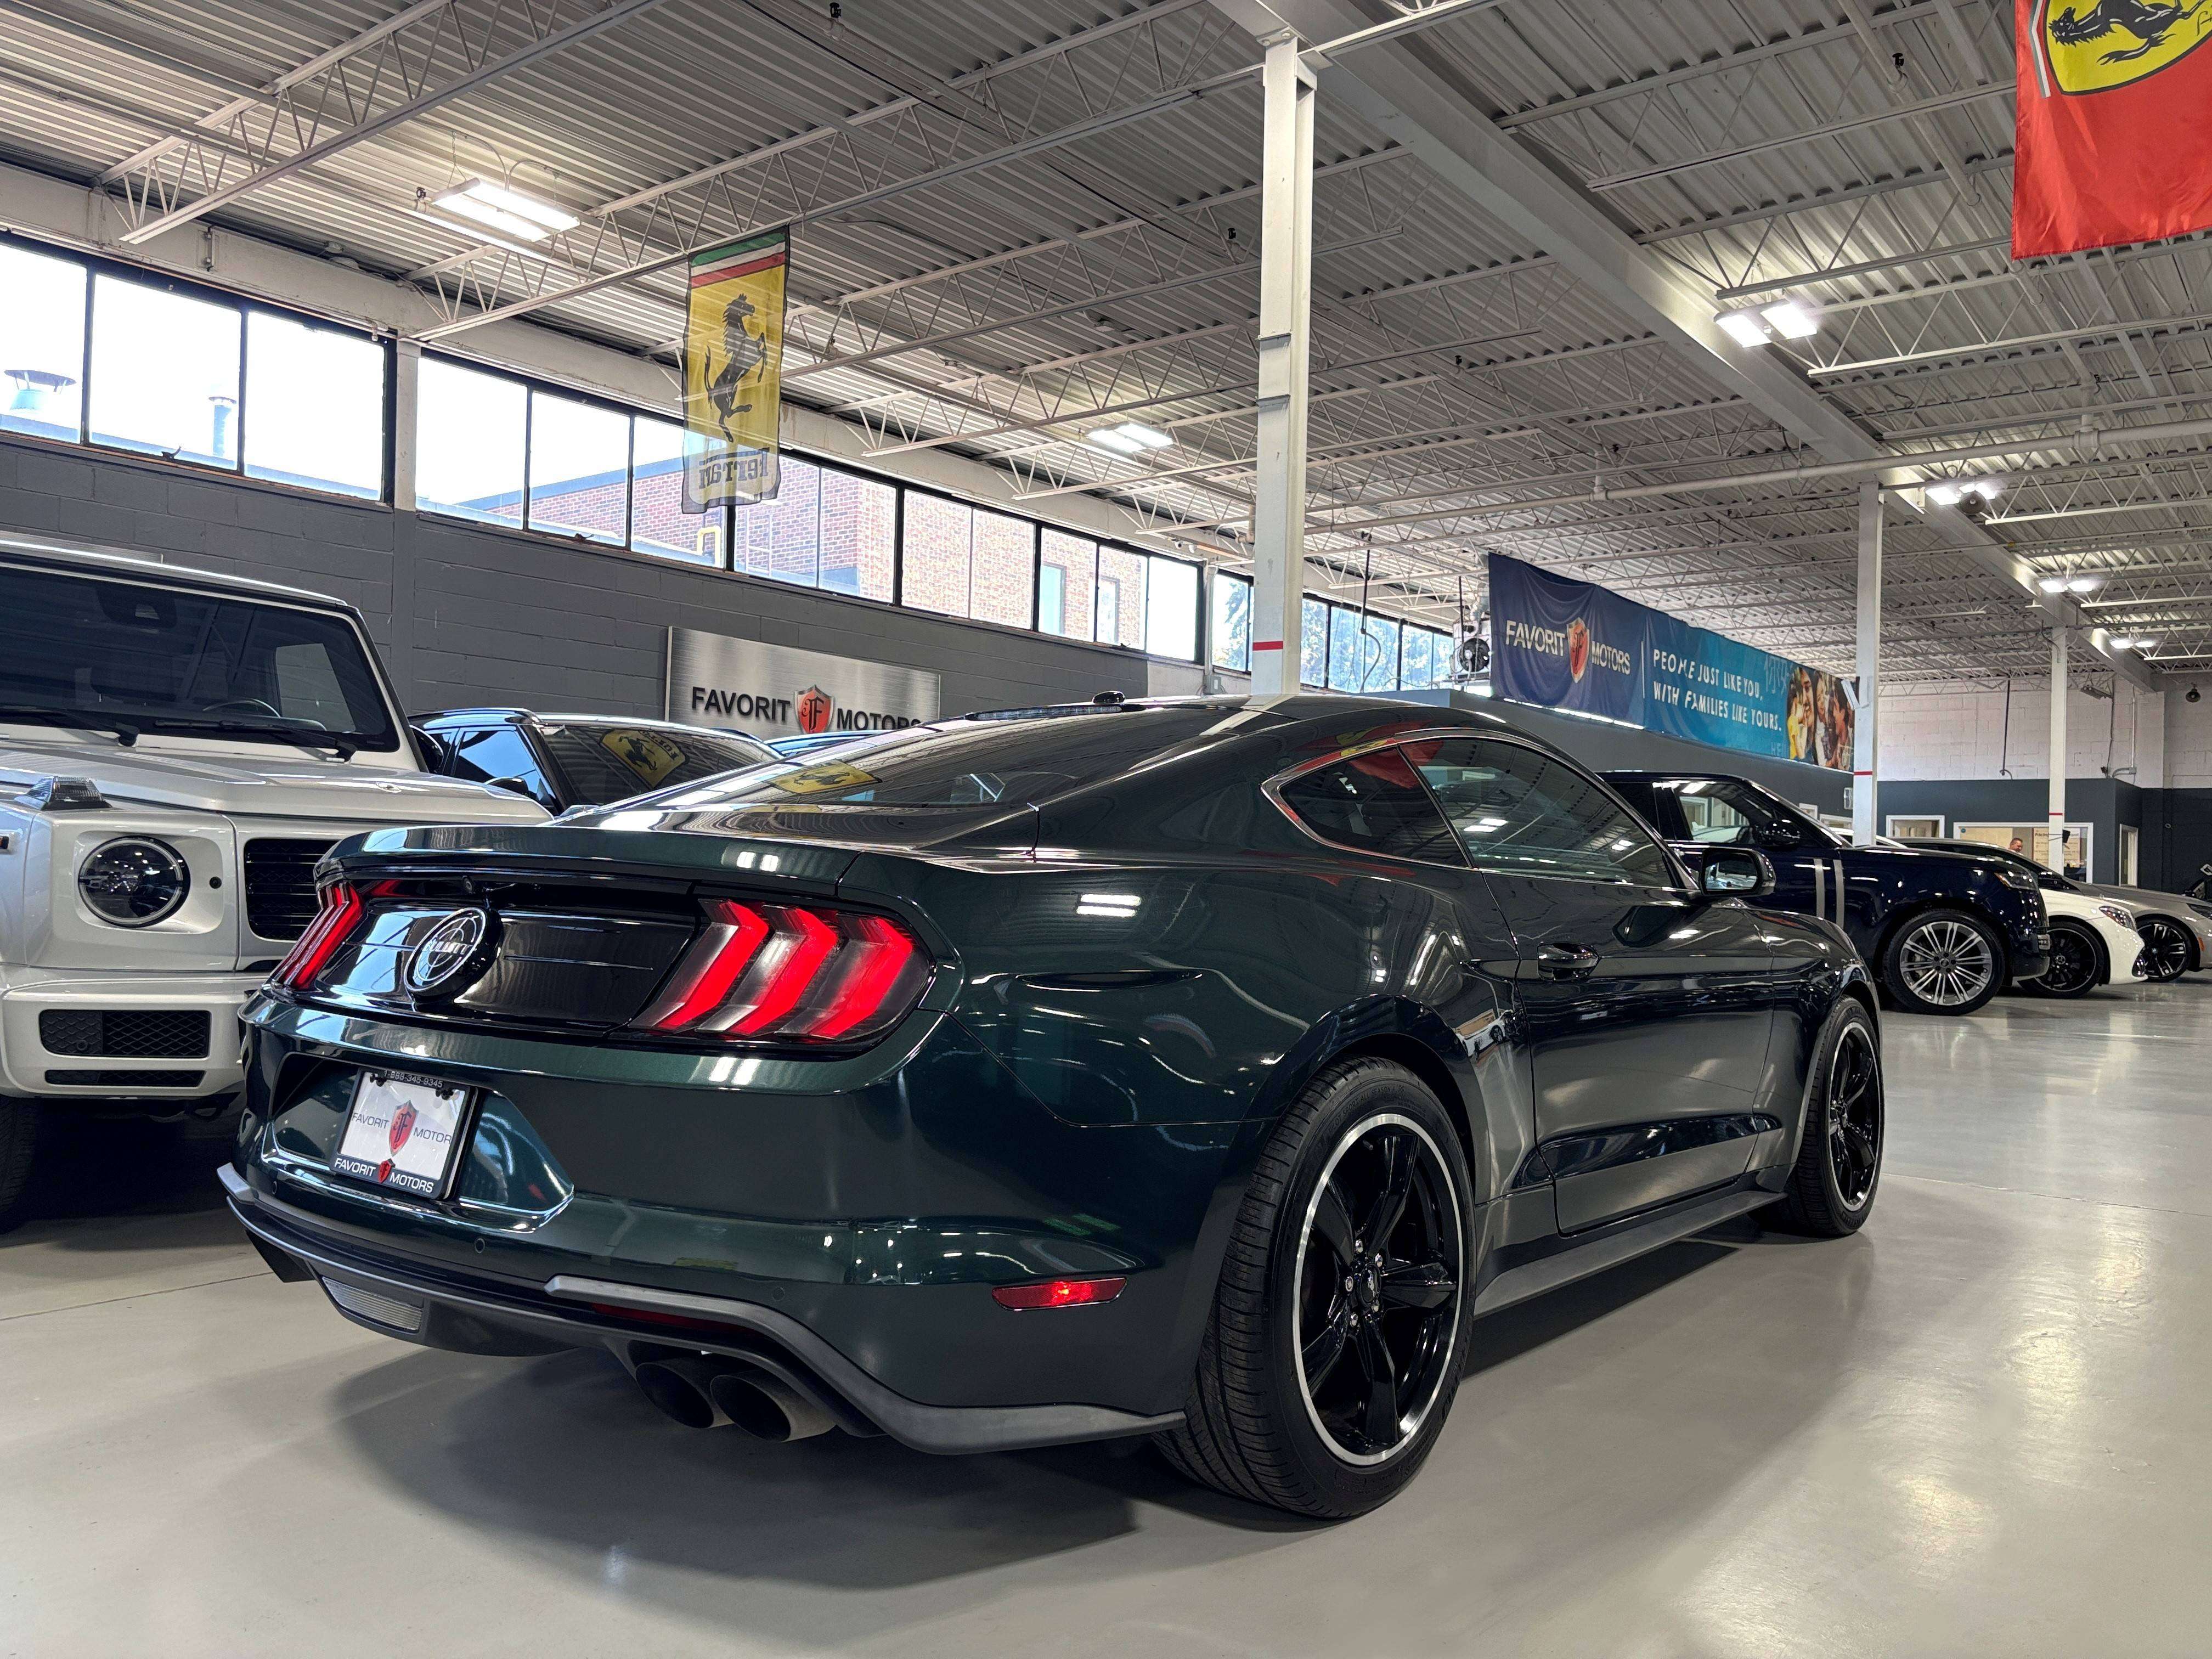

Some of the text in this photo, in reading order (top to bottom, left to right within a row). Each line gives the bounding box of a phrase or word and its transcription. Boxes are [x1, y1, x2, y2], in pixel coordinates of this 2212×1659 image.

[1505, 620, 1565, 656] FAVORIT
[1592, 640, 1630, 675] MOTORS
[1697, 664, 1719, 686] JUST
[1724, 672, 1741, 692] LIKE
[1743, 678, 1763, 701] YOU,
[692, 686, 791, 721] FAVORIT
[837, 708, 921, 730] MOTOR
[1654, 681, 1782, 731] WITH FAMILIES LIKE YOURS.
[383, 1070, 443, 1088] 1-888-345-9345
[1343, 1098, 1359, 1116] SPORT
[1361, 1092, 1369, 1102] ALL
[1372, 1085, 1391, 1094] SEASON
[352, 1112, 390, 1129] FAVORIT
[334, 1158, 434, 1194] FAVORIT MOTORS
